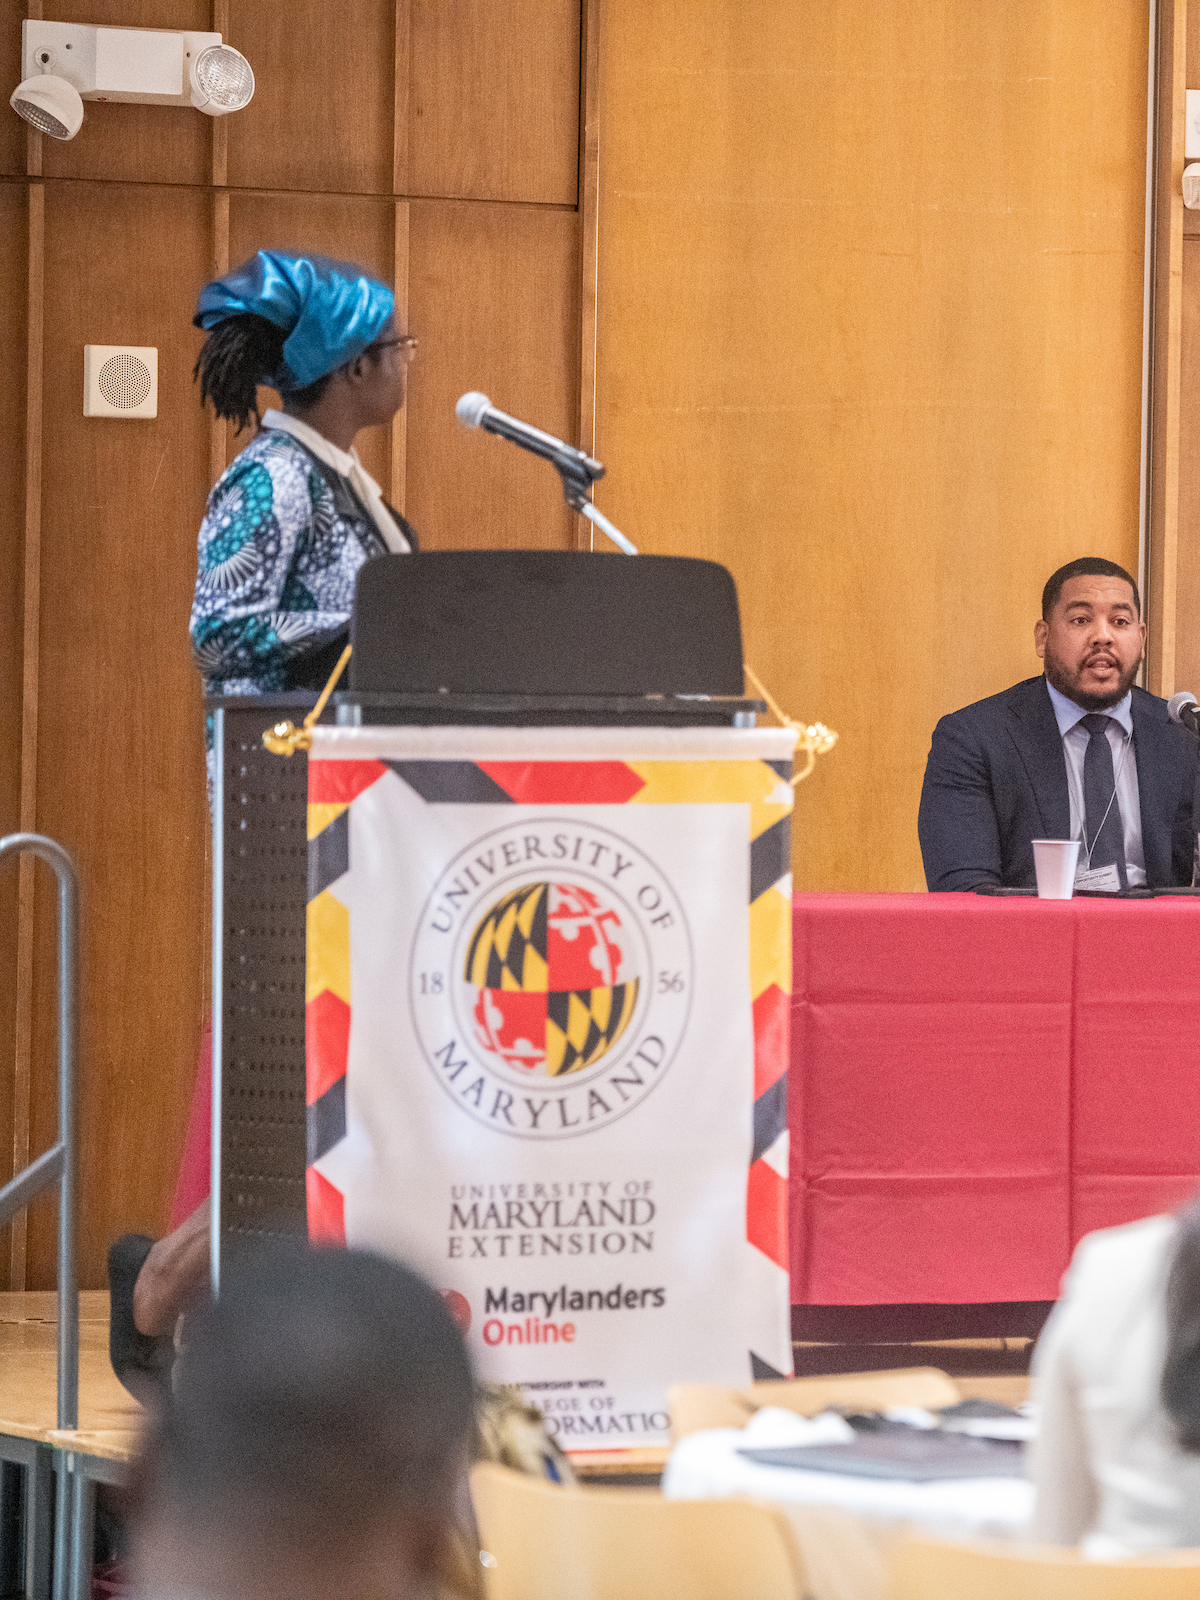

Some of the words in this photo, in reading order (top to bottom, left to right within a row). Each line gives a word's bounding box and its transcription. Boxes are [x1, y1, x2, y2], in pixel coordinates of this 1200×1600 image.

[432, 833, 634, 935] UNIVERSITY
[637, 884, 674, 931] OF
[418, 971, 444, 996] 18
[657, 970, 685, 995] 56
[434, 1034, 666, 1129] MARYLAND
[451, 1182, 613, 1201] UNIVERSITY
[624, 1180, 655, 1196] OF
[448, 1198, 656, 1230] MARYLAND
[447, 1231, 655, 1259] EXTENSION
[484, 1283, 666, 1318] Marylanders
[482, 1318, 576, 1346] Online
[589, 1396, 616, 1411] OF
